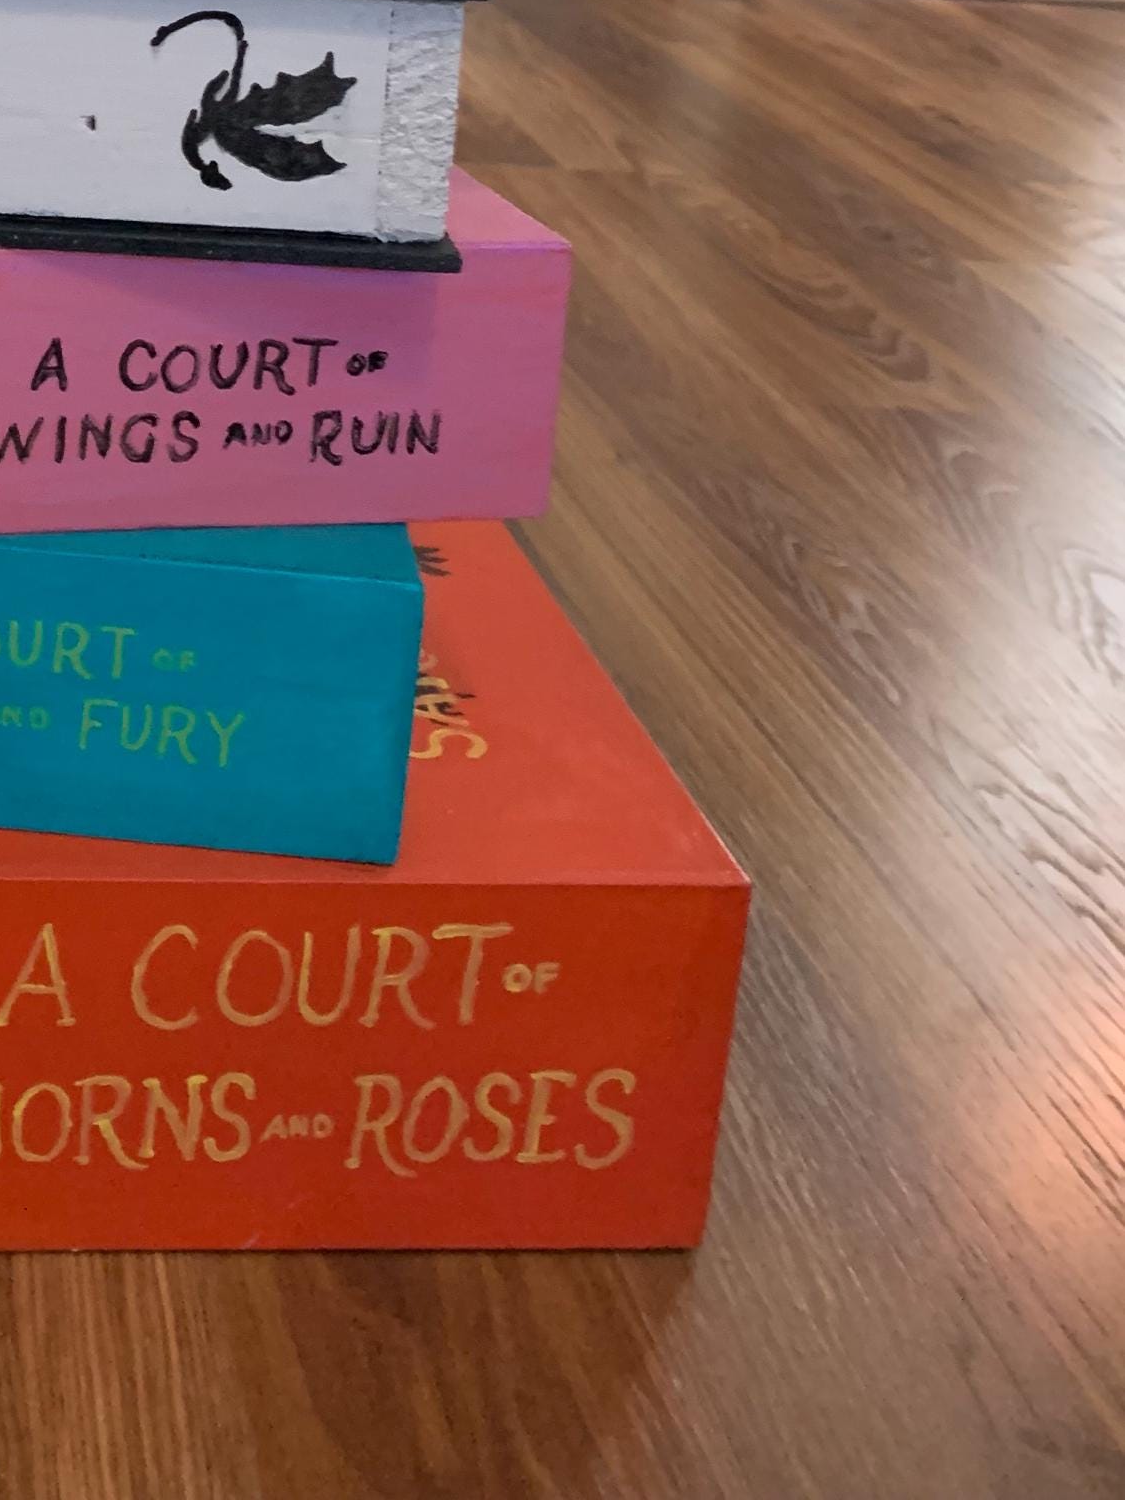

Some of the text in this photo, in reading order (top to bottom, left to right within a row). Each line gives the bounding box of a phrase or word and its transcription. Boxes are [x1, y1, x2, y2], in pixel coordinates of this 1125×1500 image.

[29, 336, 390, 396] A COURT OF
[221, 418, 294, 451] AND
[309, 408, 443, 467] RUIN
[150, 646, 198, 673] OF
[78, 698, 246, 769] FURY
[130, 922, 515, 1031] COURT
[501, 961, 561, 995] OF
[258, 1111, 335, 1144] AND
[342, 1067, 638, 1181] ROSES
